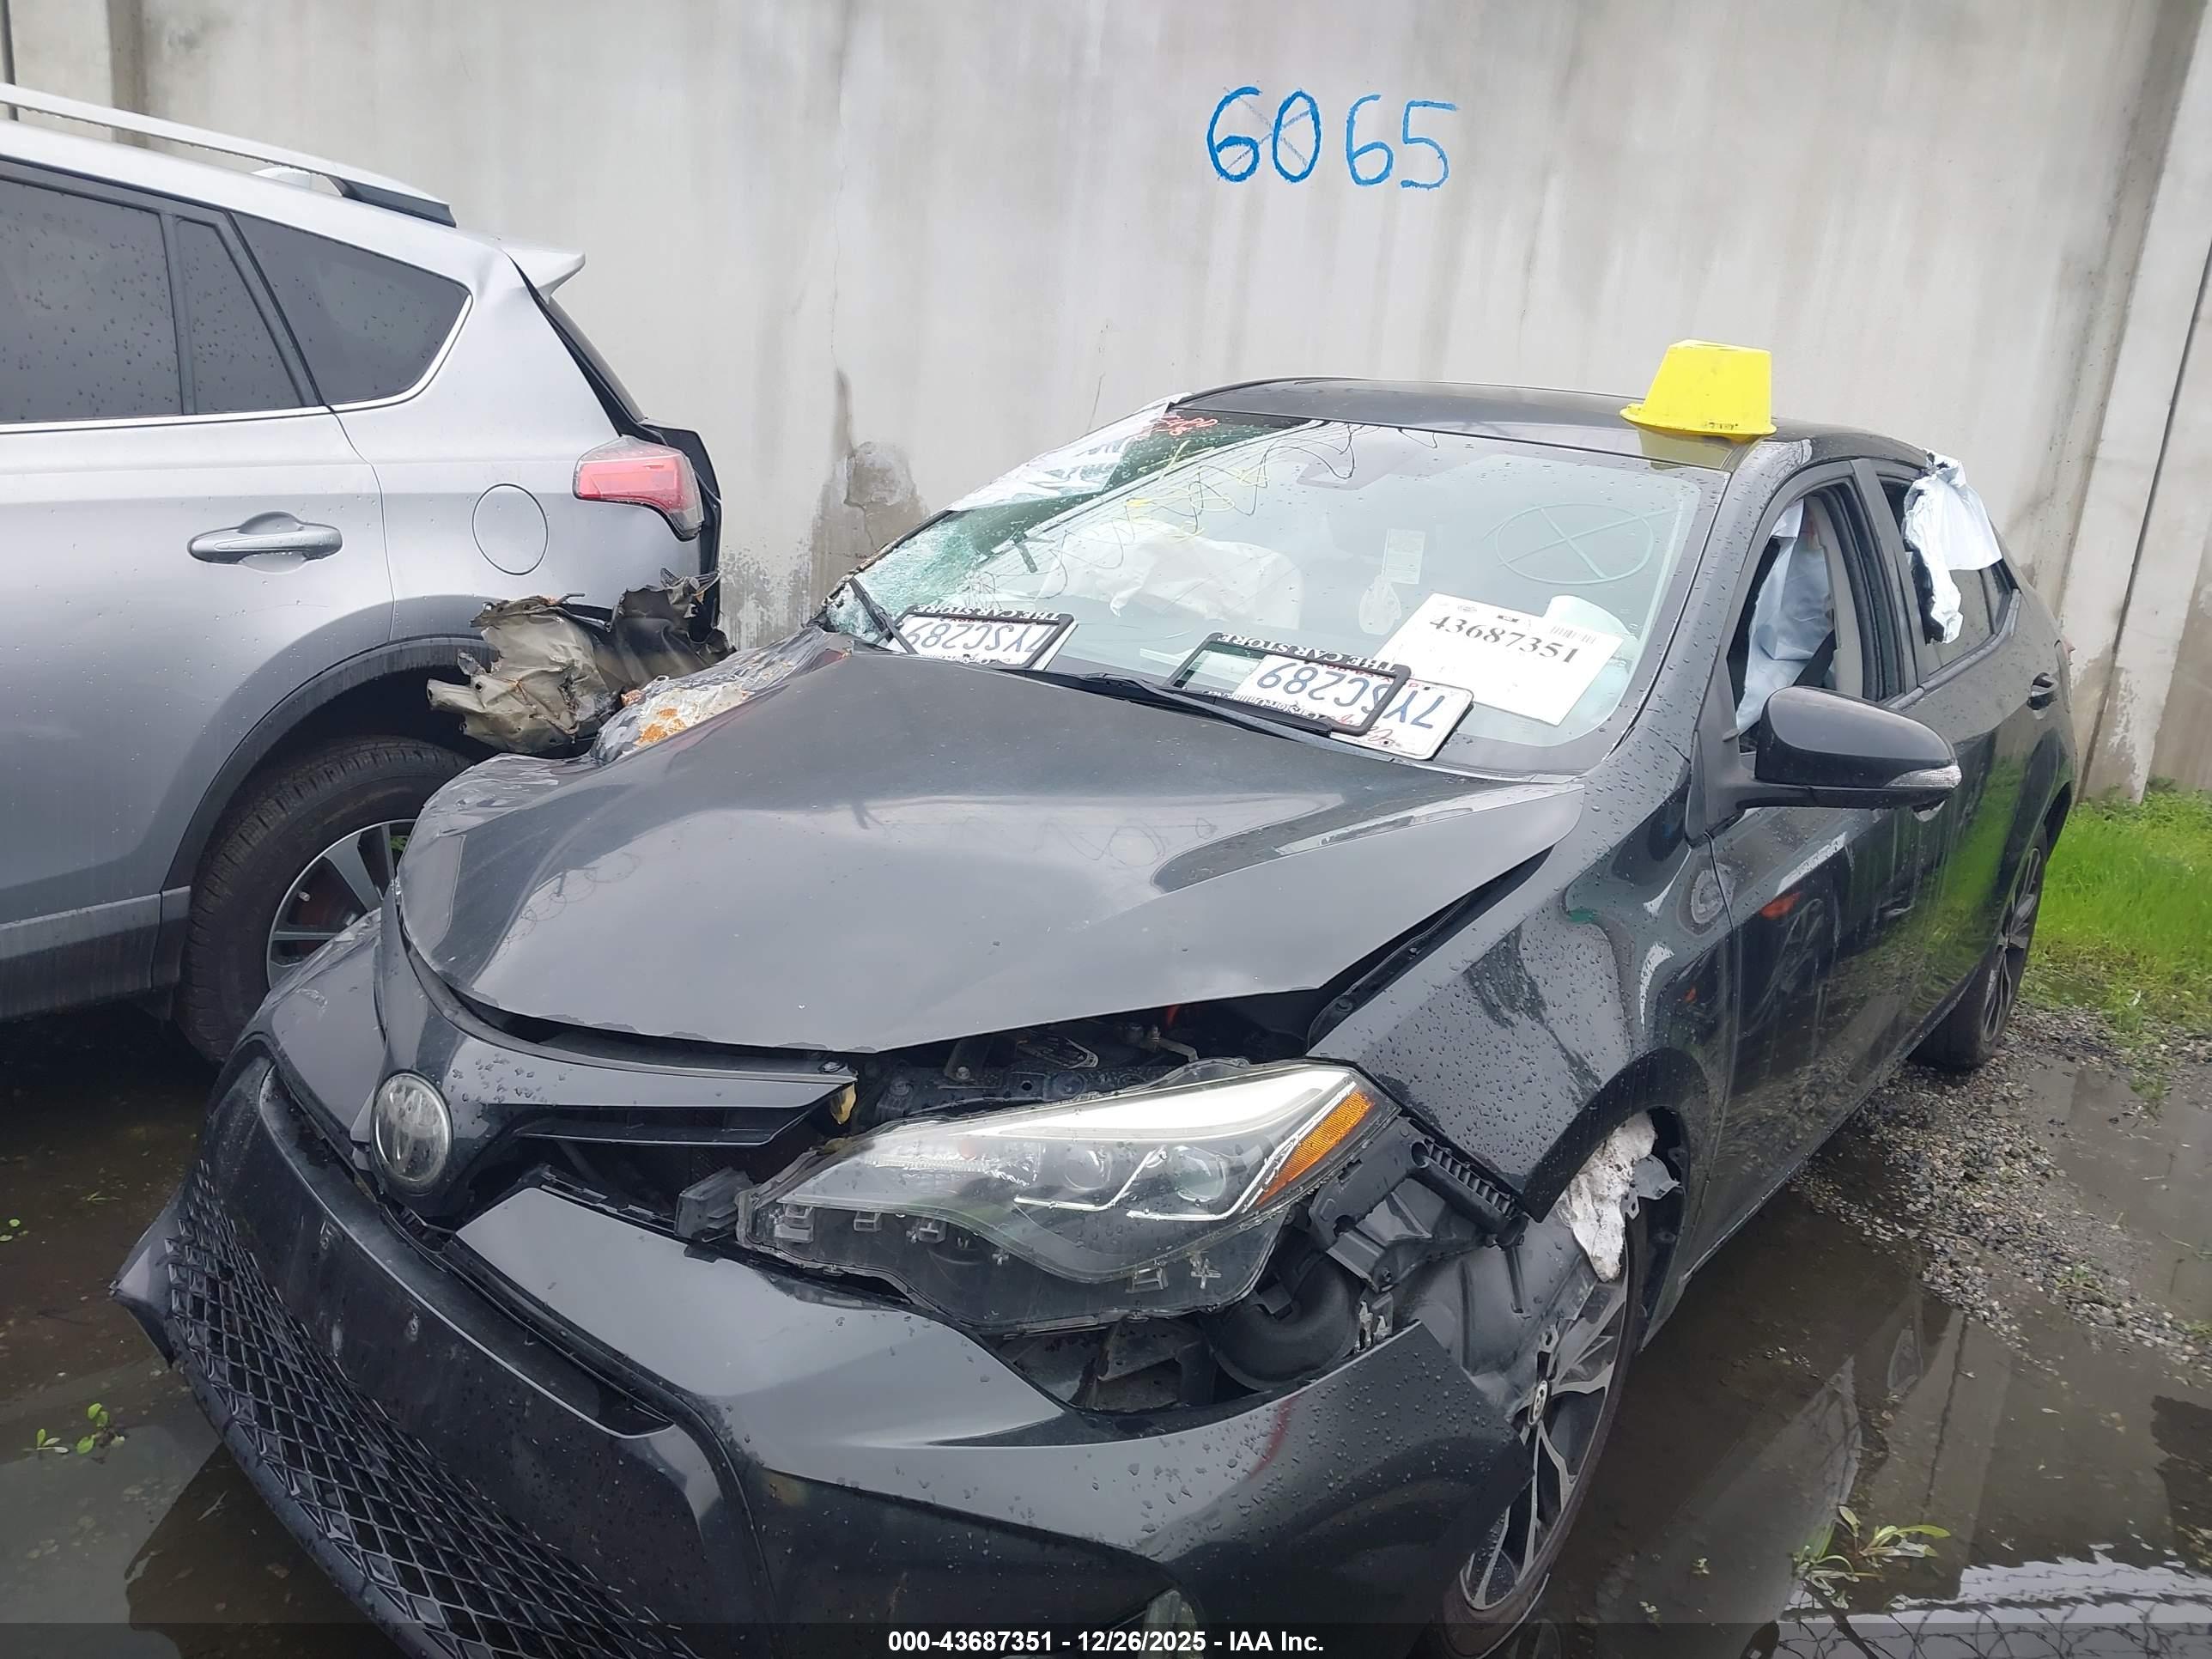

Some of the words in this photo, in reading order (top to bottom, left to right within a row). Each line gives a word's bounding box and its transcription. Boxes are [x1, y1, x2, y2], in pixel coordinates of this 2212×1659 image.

[1206, 86, 1459, 190] 6065
[914, 605, 972, 615] STORE
[976, 609, 1017, 617] CAR
[906, 621, 1053, 653] 7YSC289
[1218, 633, 1289, 653] STORE
[1429, 615, 1579, 664] 43687351
[1294, 647, 1343, 663] CAR
[1346, 656, 1396, 673] THE
